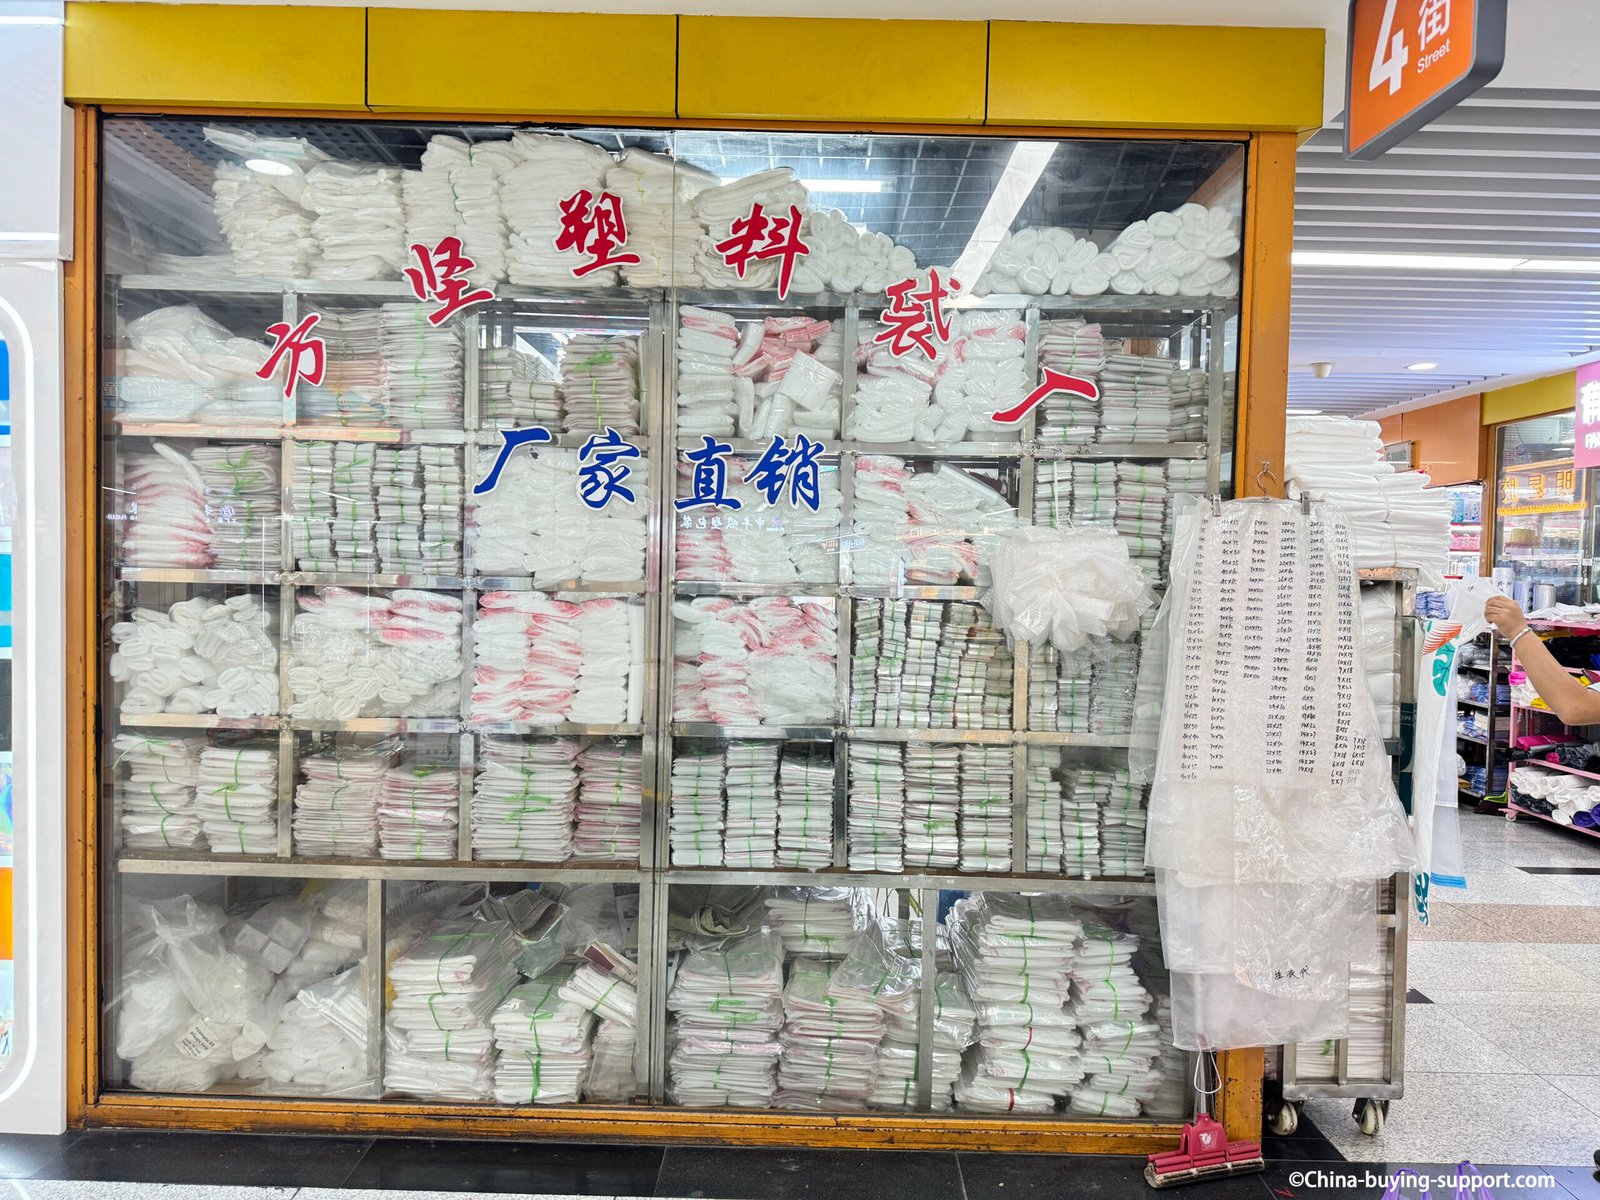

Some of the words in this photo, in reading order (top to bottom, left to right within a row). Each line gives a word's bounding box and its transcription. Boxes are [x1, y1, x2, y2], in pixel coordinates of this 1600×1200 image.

[1369, 0, 1409, 96] 4
[1417, 0, 1451, 51] 街
[1417, 38, 1451, 74] Street
[474, 427, 825, 512] 厂家直销
